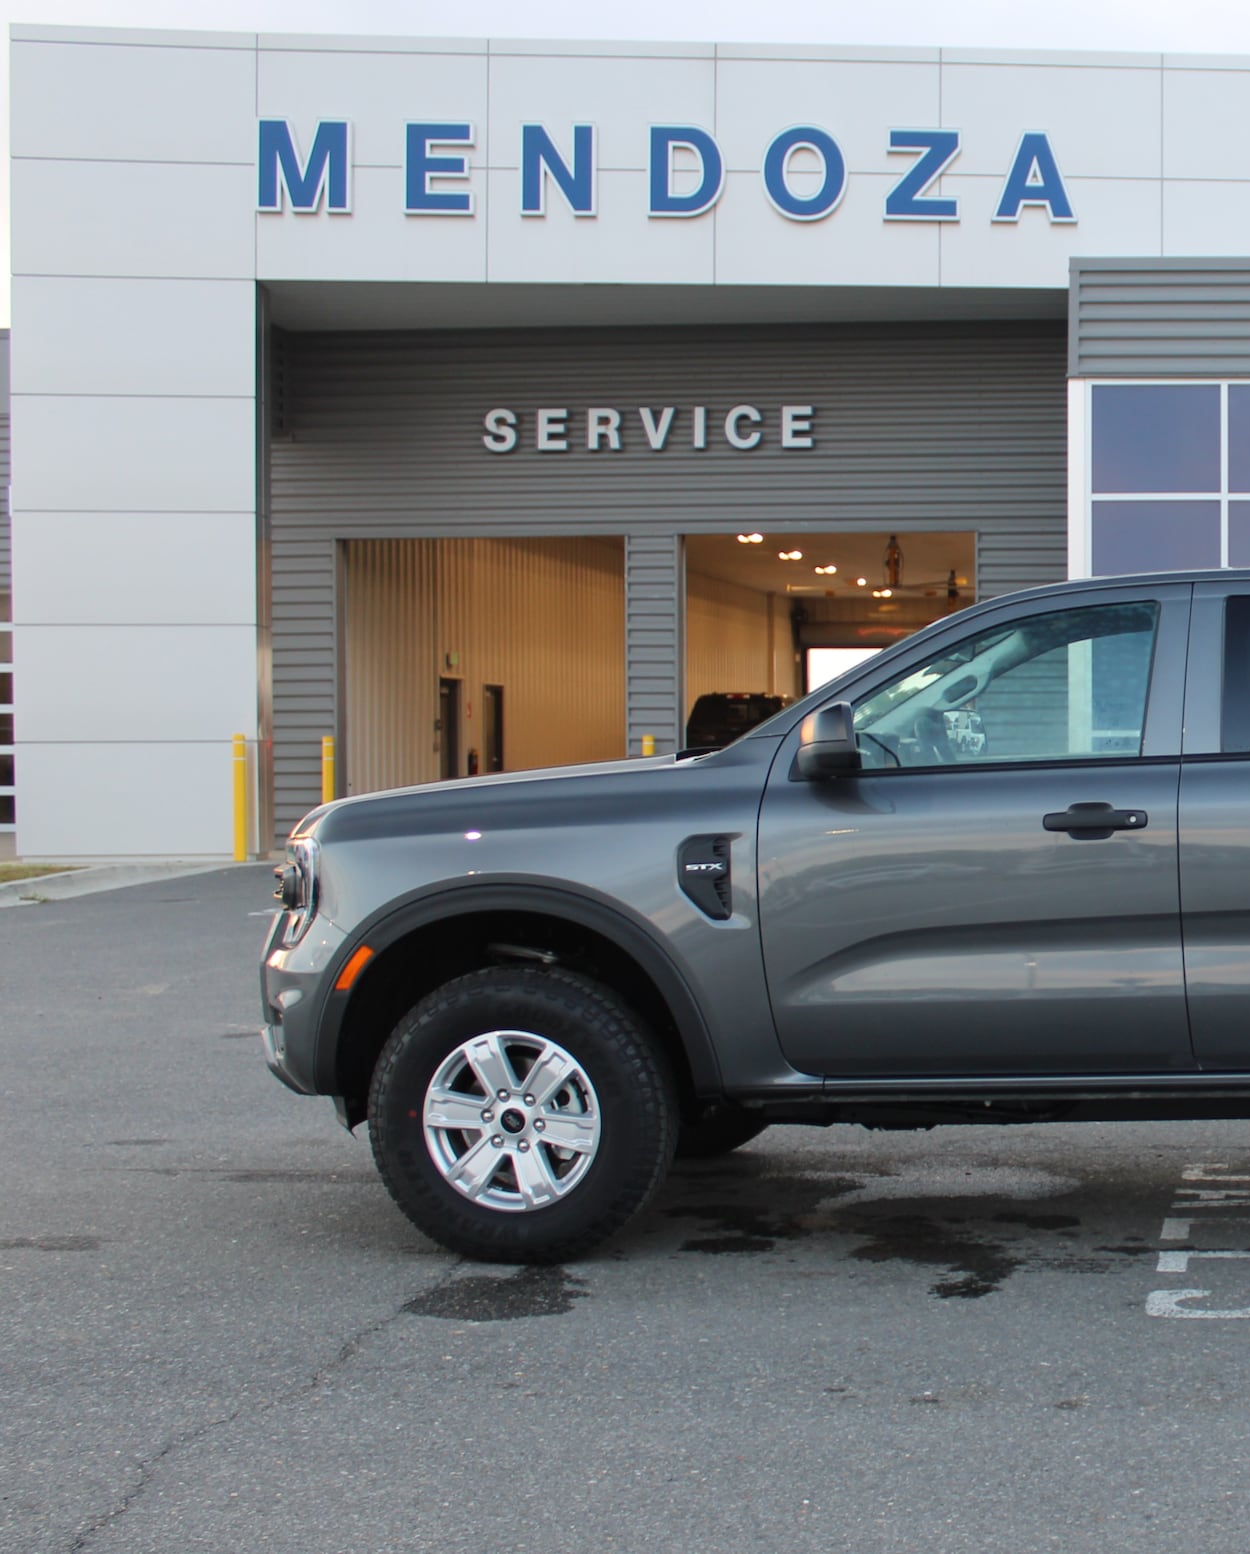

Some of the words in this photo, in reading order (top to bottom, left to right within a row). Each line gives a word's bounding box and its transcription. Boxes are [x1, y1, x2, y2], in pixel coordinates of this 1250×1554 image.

[257, 118, 1078, 224] MENDOZA
[482, 404, 816, 453] SERVICE
[685, 862, 723, 872] STX
